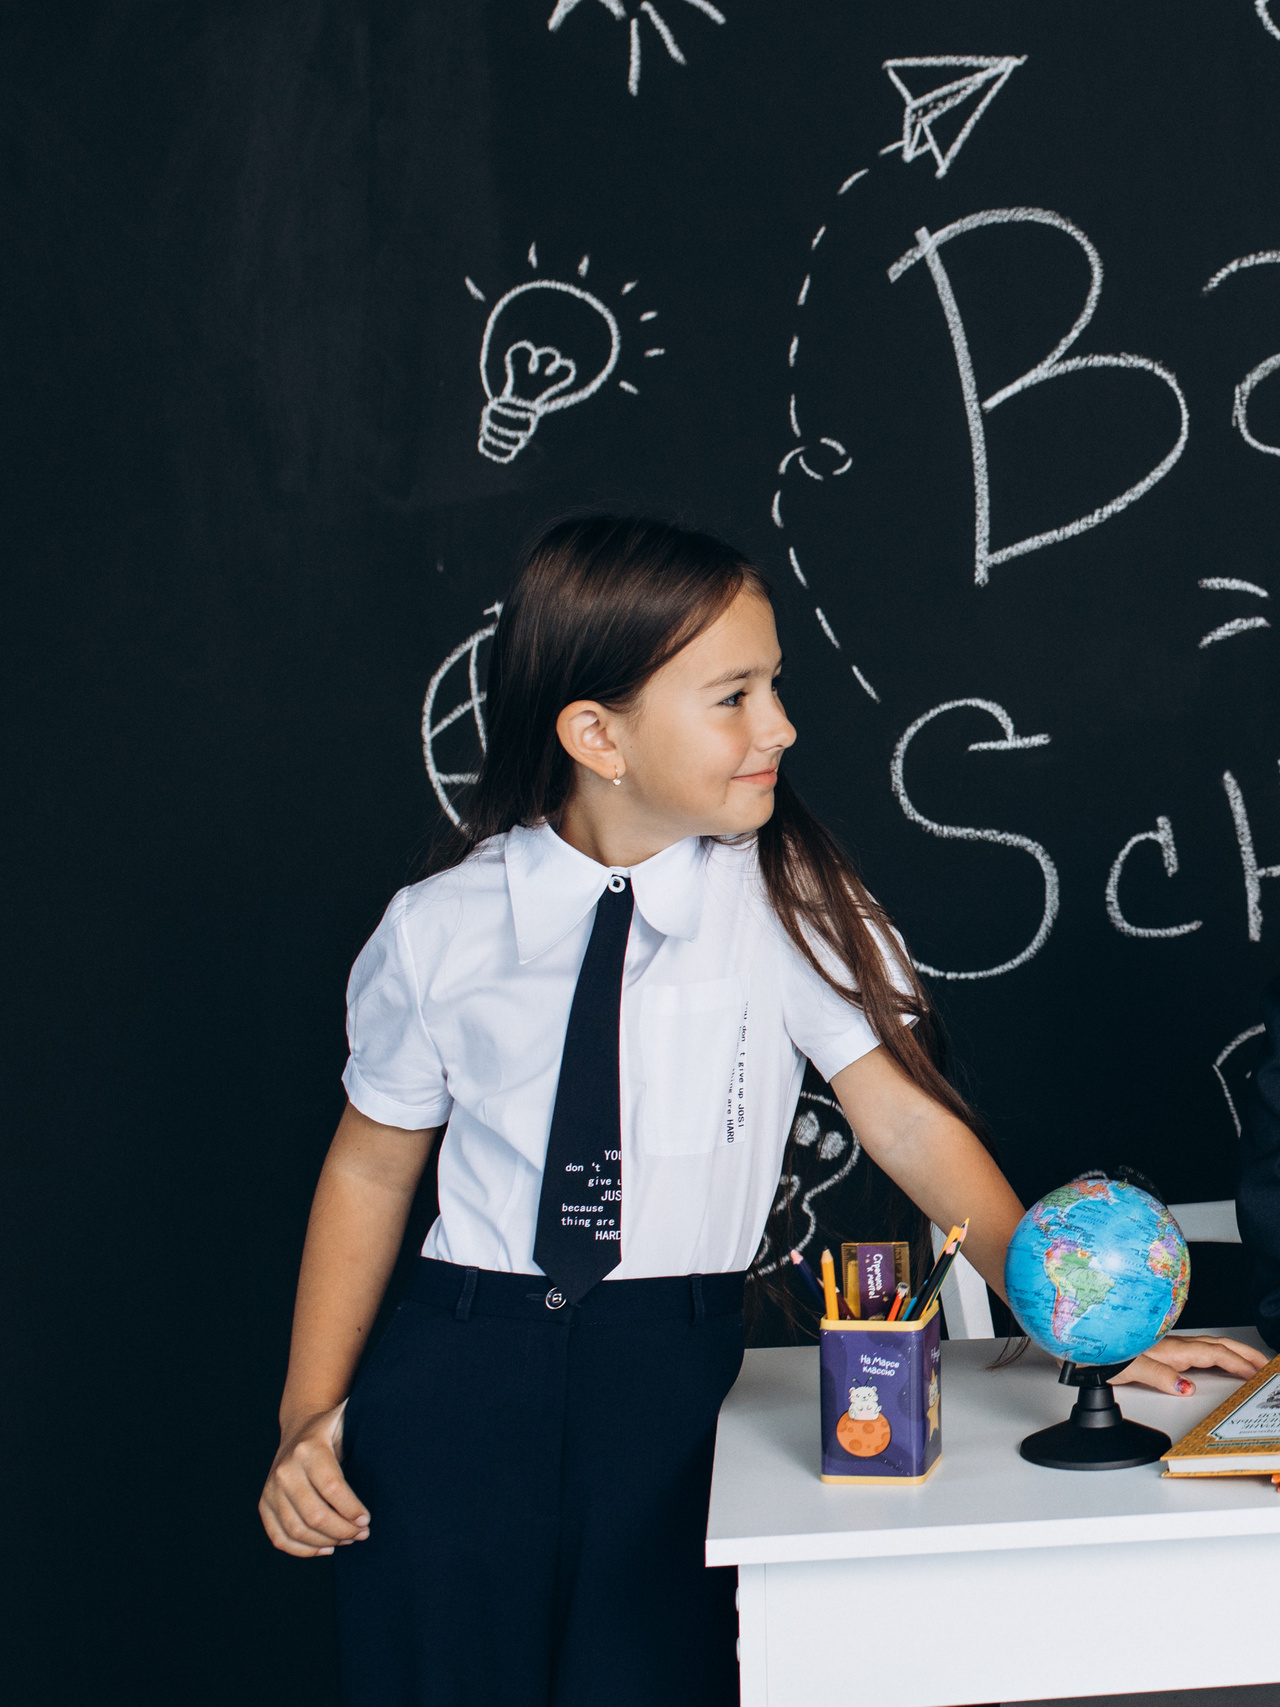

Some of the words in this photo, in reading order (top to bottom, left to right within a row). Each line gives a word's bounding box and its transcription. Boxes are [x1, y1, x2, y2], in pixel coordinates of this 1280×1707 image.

[726, 1119, 735, 1143] HARD
[565, 1162, 584, 1172] don
[587, 1176, 612, 1188] give
[561, 1203, 604, 1212] because
[561, 1216, 591, 1228] thing
[860, 1353, 871, 1365] На
